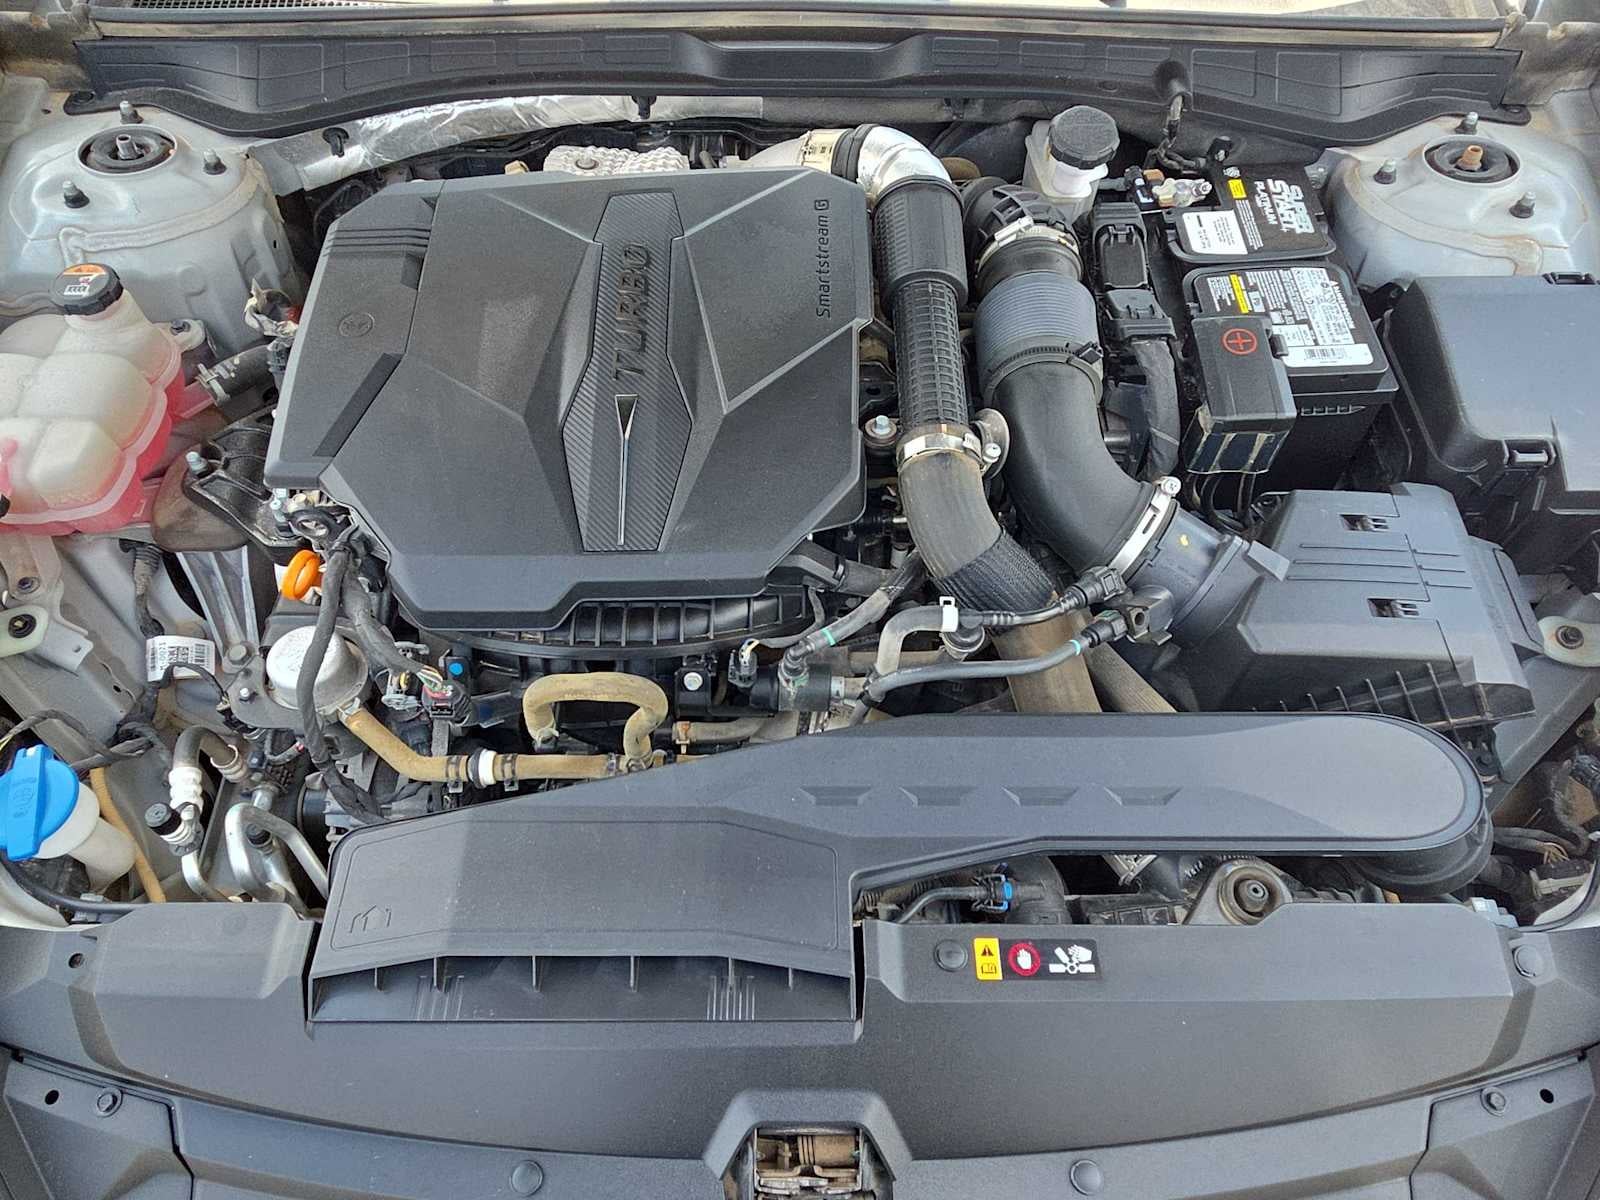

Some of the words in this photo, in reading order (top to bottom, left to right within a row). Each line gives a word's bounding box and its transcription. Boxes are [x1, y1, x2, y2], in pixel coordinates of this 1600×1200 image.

[814, 199, 830, 211] G
[1254, 181, 1279, 224] PLATINUM
[1267, 179, 1297, 230] START
[1290, 185, 1315, 233] SUPER
[815, 215, 831, 318] Smartstream
[613, 243, 650, 381] TURBO
